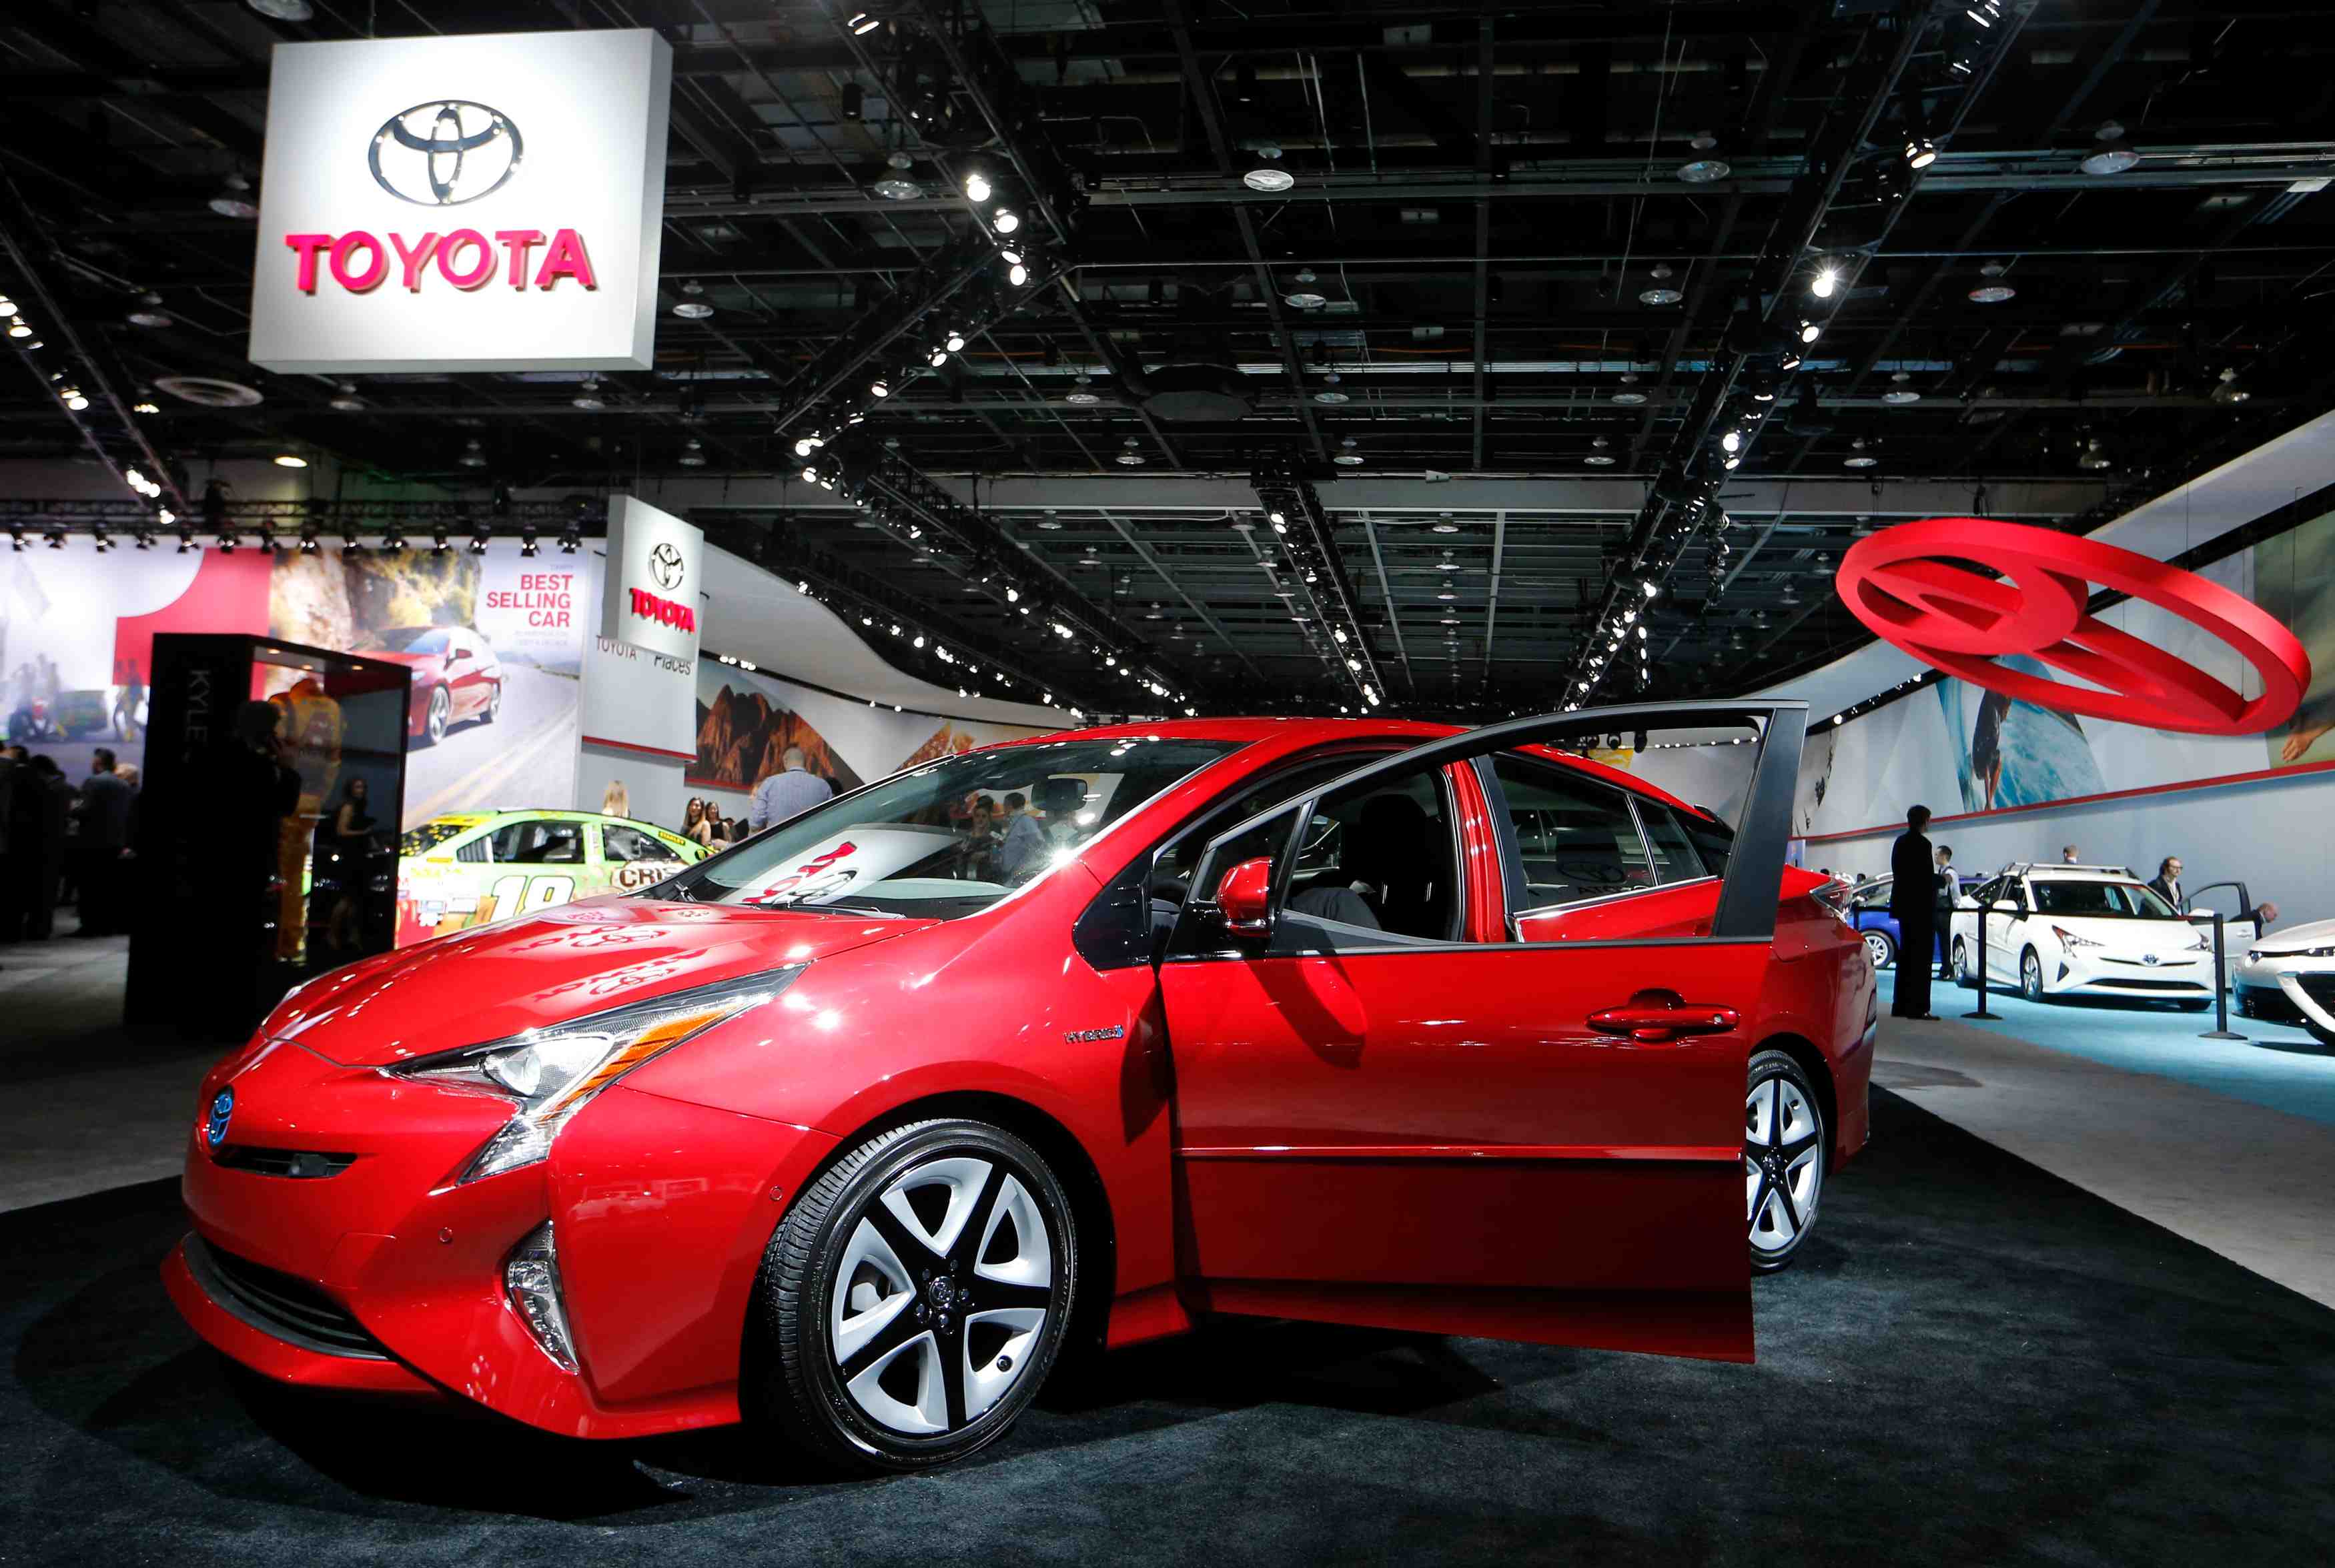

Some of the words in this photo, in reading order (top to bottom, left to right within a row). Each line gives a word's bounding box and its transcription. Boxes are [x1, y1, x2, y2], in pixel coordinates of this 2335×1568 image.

[285, 229, 598, 295] TOYOTA
[521, 574, 574, 590] BEST
[486, 592, 571, 608] SELLING
[629, 587, 695, 634] TOYOTA
[529, 611, 570, 627] CAR
[187, 670, 211, 742] KYLE
